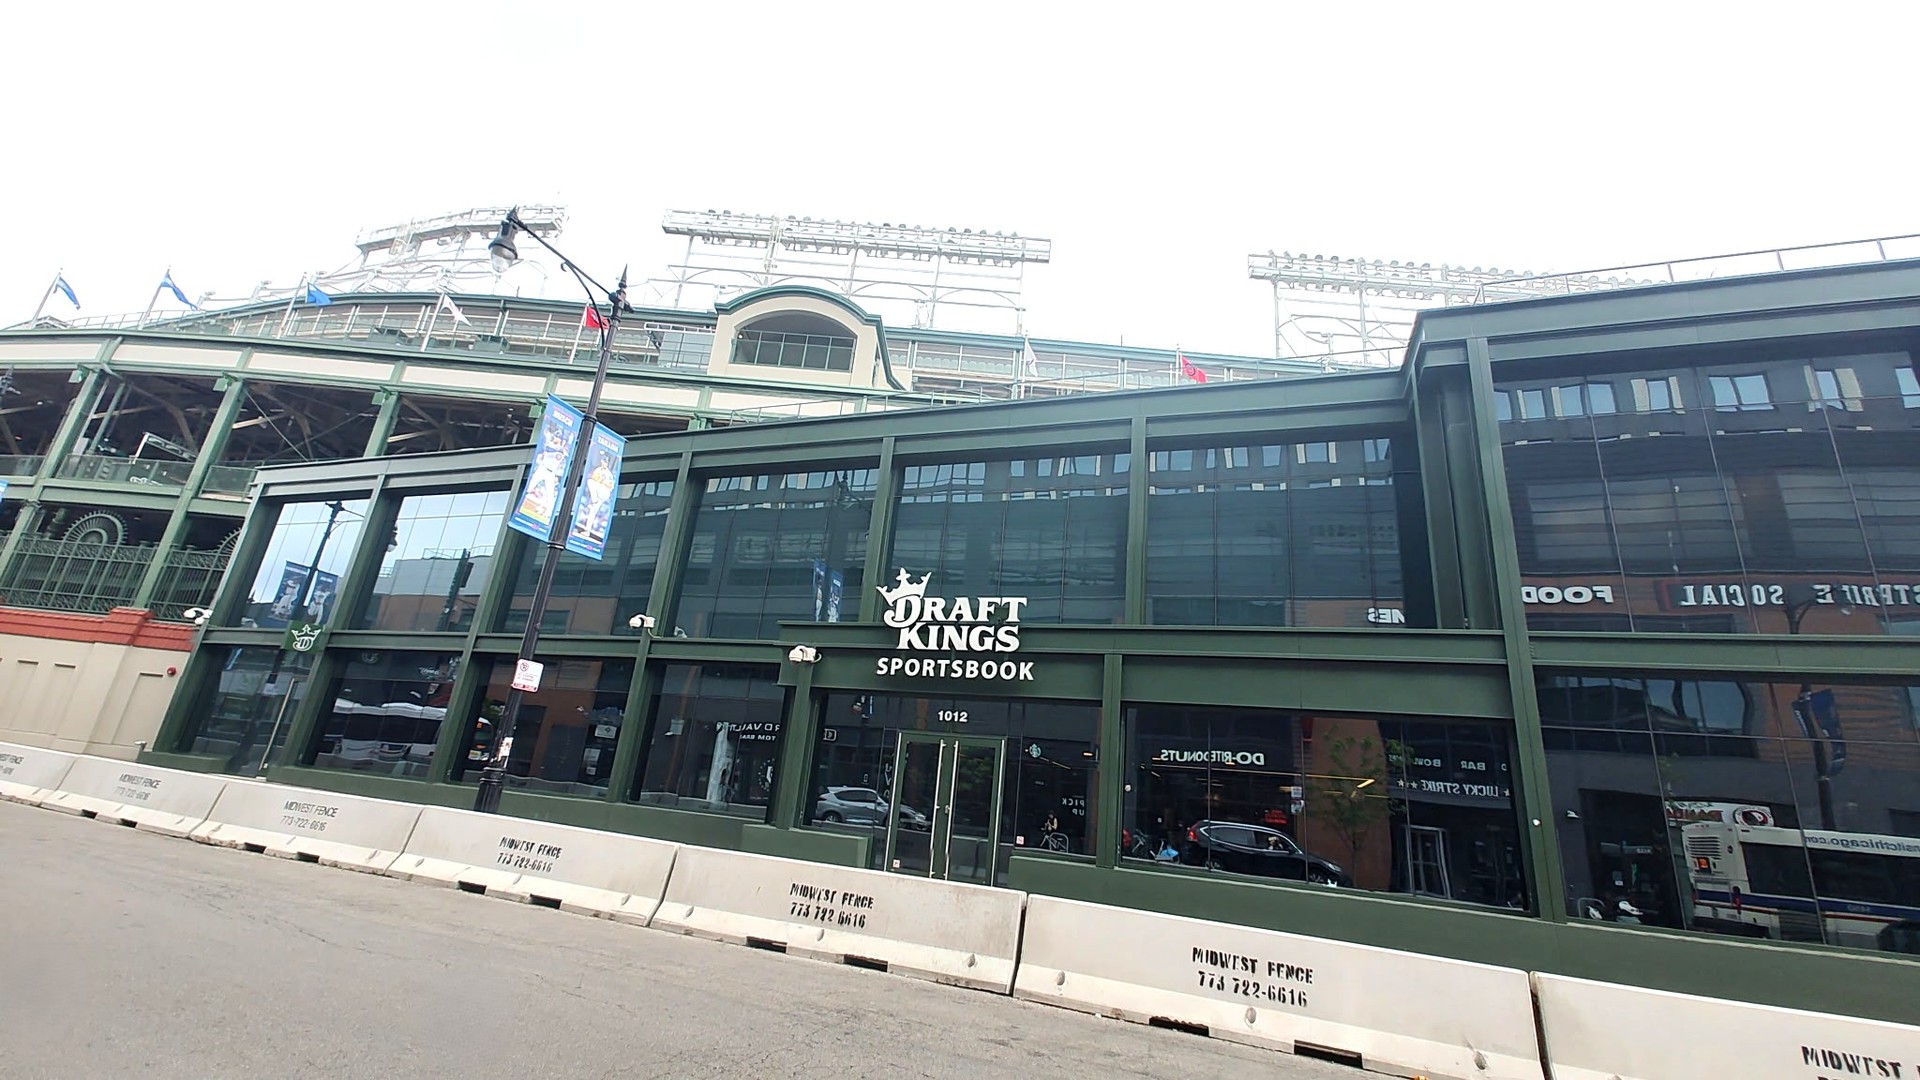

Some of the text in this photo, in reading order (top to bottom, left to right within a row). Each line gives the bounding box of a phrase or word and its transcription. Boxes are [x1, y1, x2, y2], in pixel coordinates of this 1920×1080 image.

[883, 594, 1028, 628] DRAFT
[896, 621, 1020, 652] KINGS
[876, 657, 1035, 681] SPORTSBOOK
[937, 710, 968, 723] 1012
[284, 800, 338, 818] MIDWEST FENCE
[789, 883, 874, 909] MIDWEST FENCE
[790, 901, 811, 918] 773
[1192, 946, 1313, 984] MIDWEST FENCE
